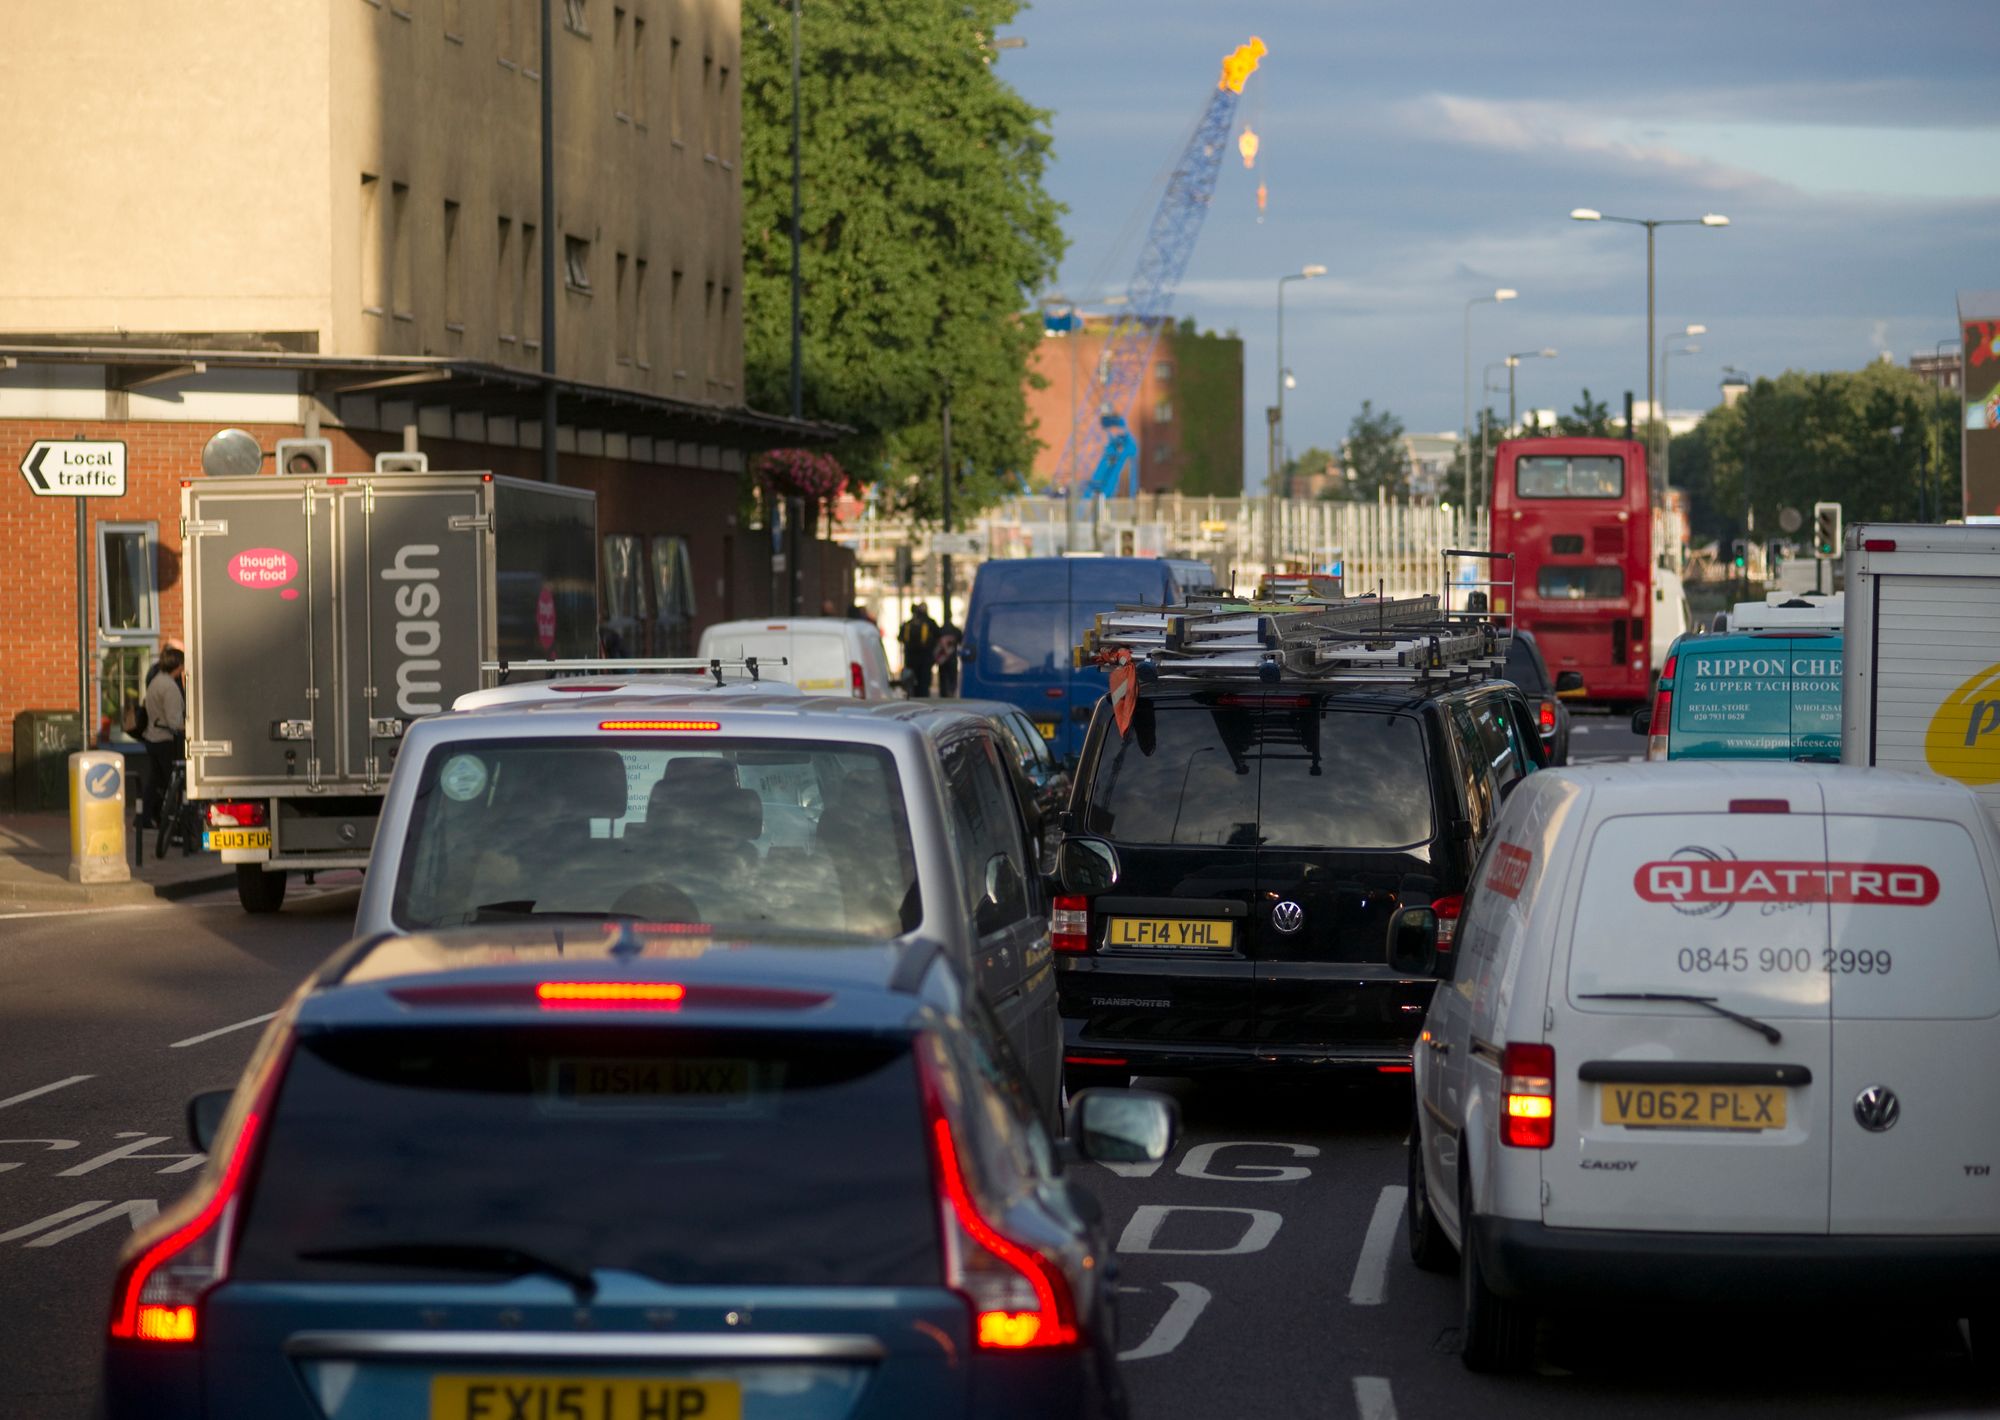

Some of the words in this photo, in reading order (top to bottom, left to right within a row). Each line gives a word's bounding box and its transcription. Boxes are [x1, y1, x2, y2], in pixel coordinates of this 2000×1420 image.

[63, 450, 112, 465] Local
[59, 471, 117, 486] traffic
[239, 554, 287, 569] thought
[239, 569, 257, 582] for
[259, 568, 287, 582] food
[381, 544, 442, 715] mash
[1696, 659, 1786, 677] RIPPON
[1694, 682, 1707, 692] 26
[1710, 682, 1752, 692] UPPER
[1755, 682, 1840, 692] TACHBROOK
[1689, 704, 1720, 712] RETAIL
[1722, 704, 1750, 712] STORE
[1650, 865, 1925, 900] QUATTRO
[1123, 922, 1171, 943] LF14
[1178, 923, 1219, 944] YHL
[1677, 948, 1749, 973] 0845
[1759, 948, 1812, 973] 900
[1822, 949, 1893, 975] 2999
[1092, 997, 1171, 1009] TRANSPORTER
[1709, 1093, 1775, 1123] PLX
[1580, 1160, 1638, 1172] CADDY
[1963, 1165, 1991, 1177] TDI
